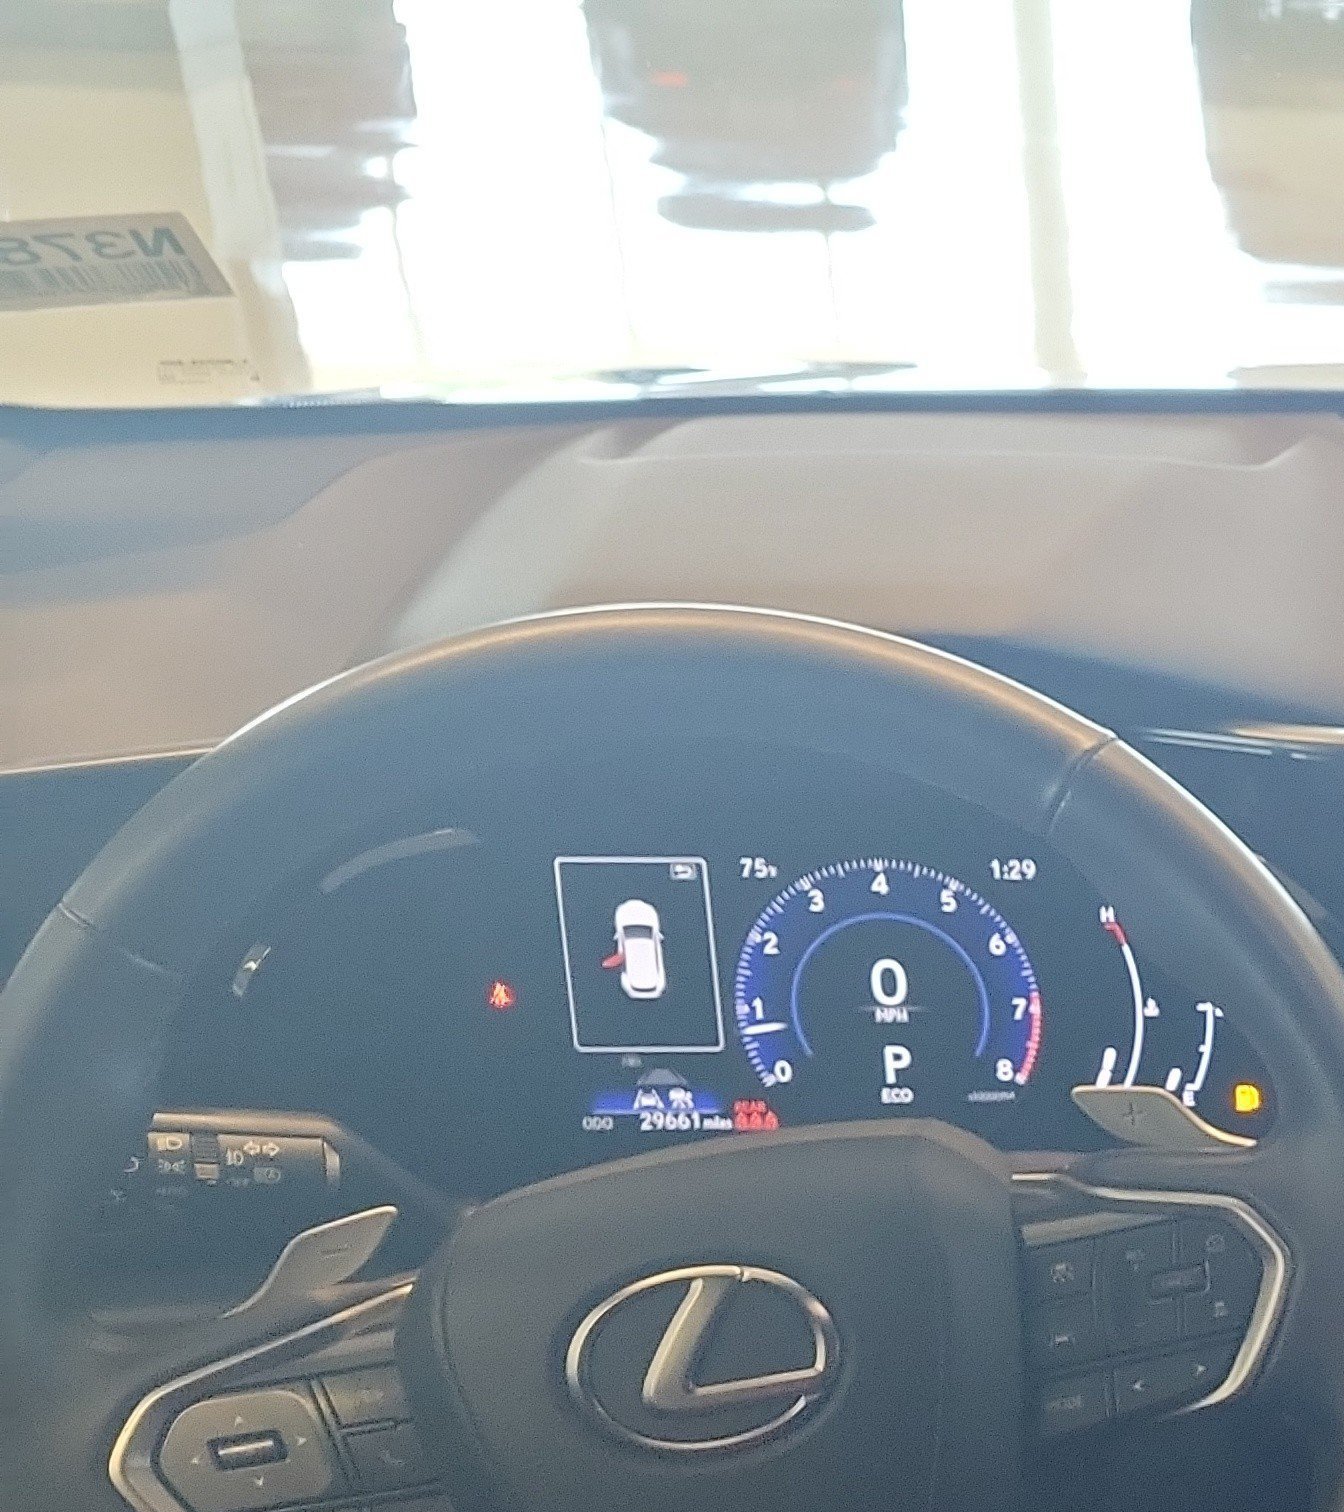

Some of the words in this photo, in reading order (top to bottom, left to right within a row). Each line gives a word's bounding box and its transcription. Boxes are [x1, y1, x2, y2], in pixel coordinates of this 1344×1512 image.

[990, 858, 1036, 881] 1:29
[870, 872, 889, 896] 4
[807, 888, 825, 913] 3
[940, 888, 957, 913] 5
[1100, 905, 1115, 922] H
[763, 930, 780, 955] 2
[988, 932, 1007, 956] 6
[870, 958, 908, 1006] 0
[752, 996, 764, 1020] 1
[874, 1007, 909, 1023] MPH
[1011, 997, 1027, 1021] 7
[773, 1060, 792, 1083] 0
[883, 1044, 912, 1084] P
[996, 1058, 1014, 1082] 8
[880, 1088, 914, 1104] ECO
[640, 1112, 701, 1131] 29661
[703, 1116, 733, 1131] miles
